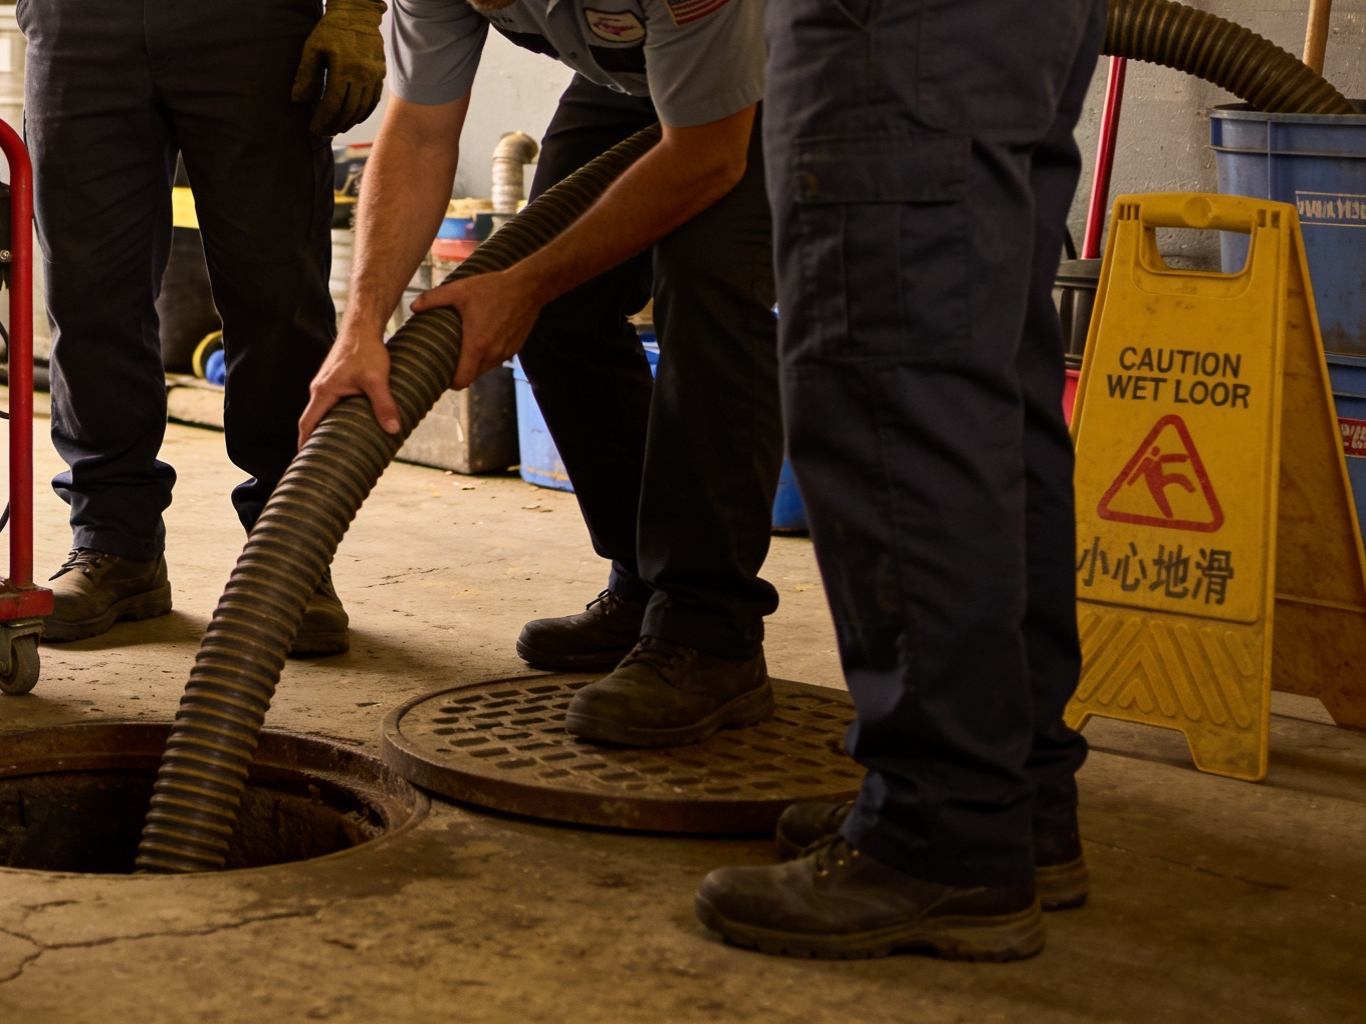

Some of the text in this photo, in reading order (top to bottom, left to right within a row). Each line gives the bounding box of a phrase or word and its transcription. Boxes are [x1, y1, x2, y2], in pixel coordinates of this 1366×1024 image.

[1119, 346, 1242, 379] CAUTION
[1106, 373, 1251, 409] WET LOOR
[1076, 536, 1235, 606] 小心地滑
